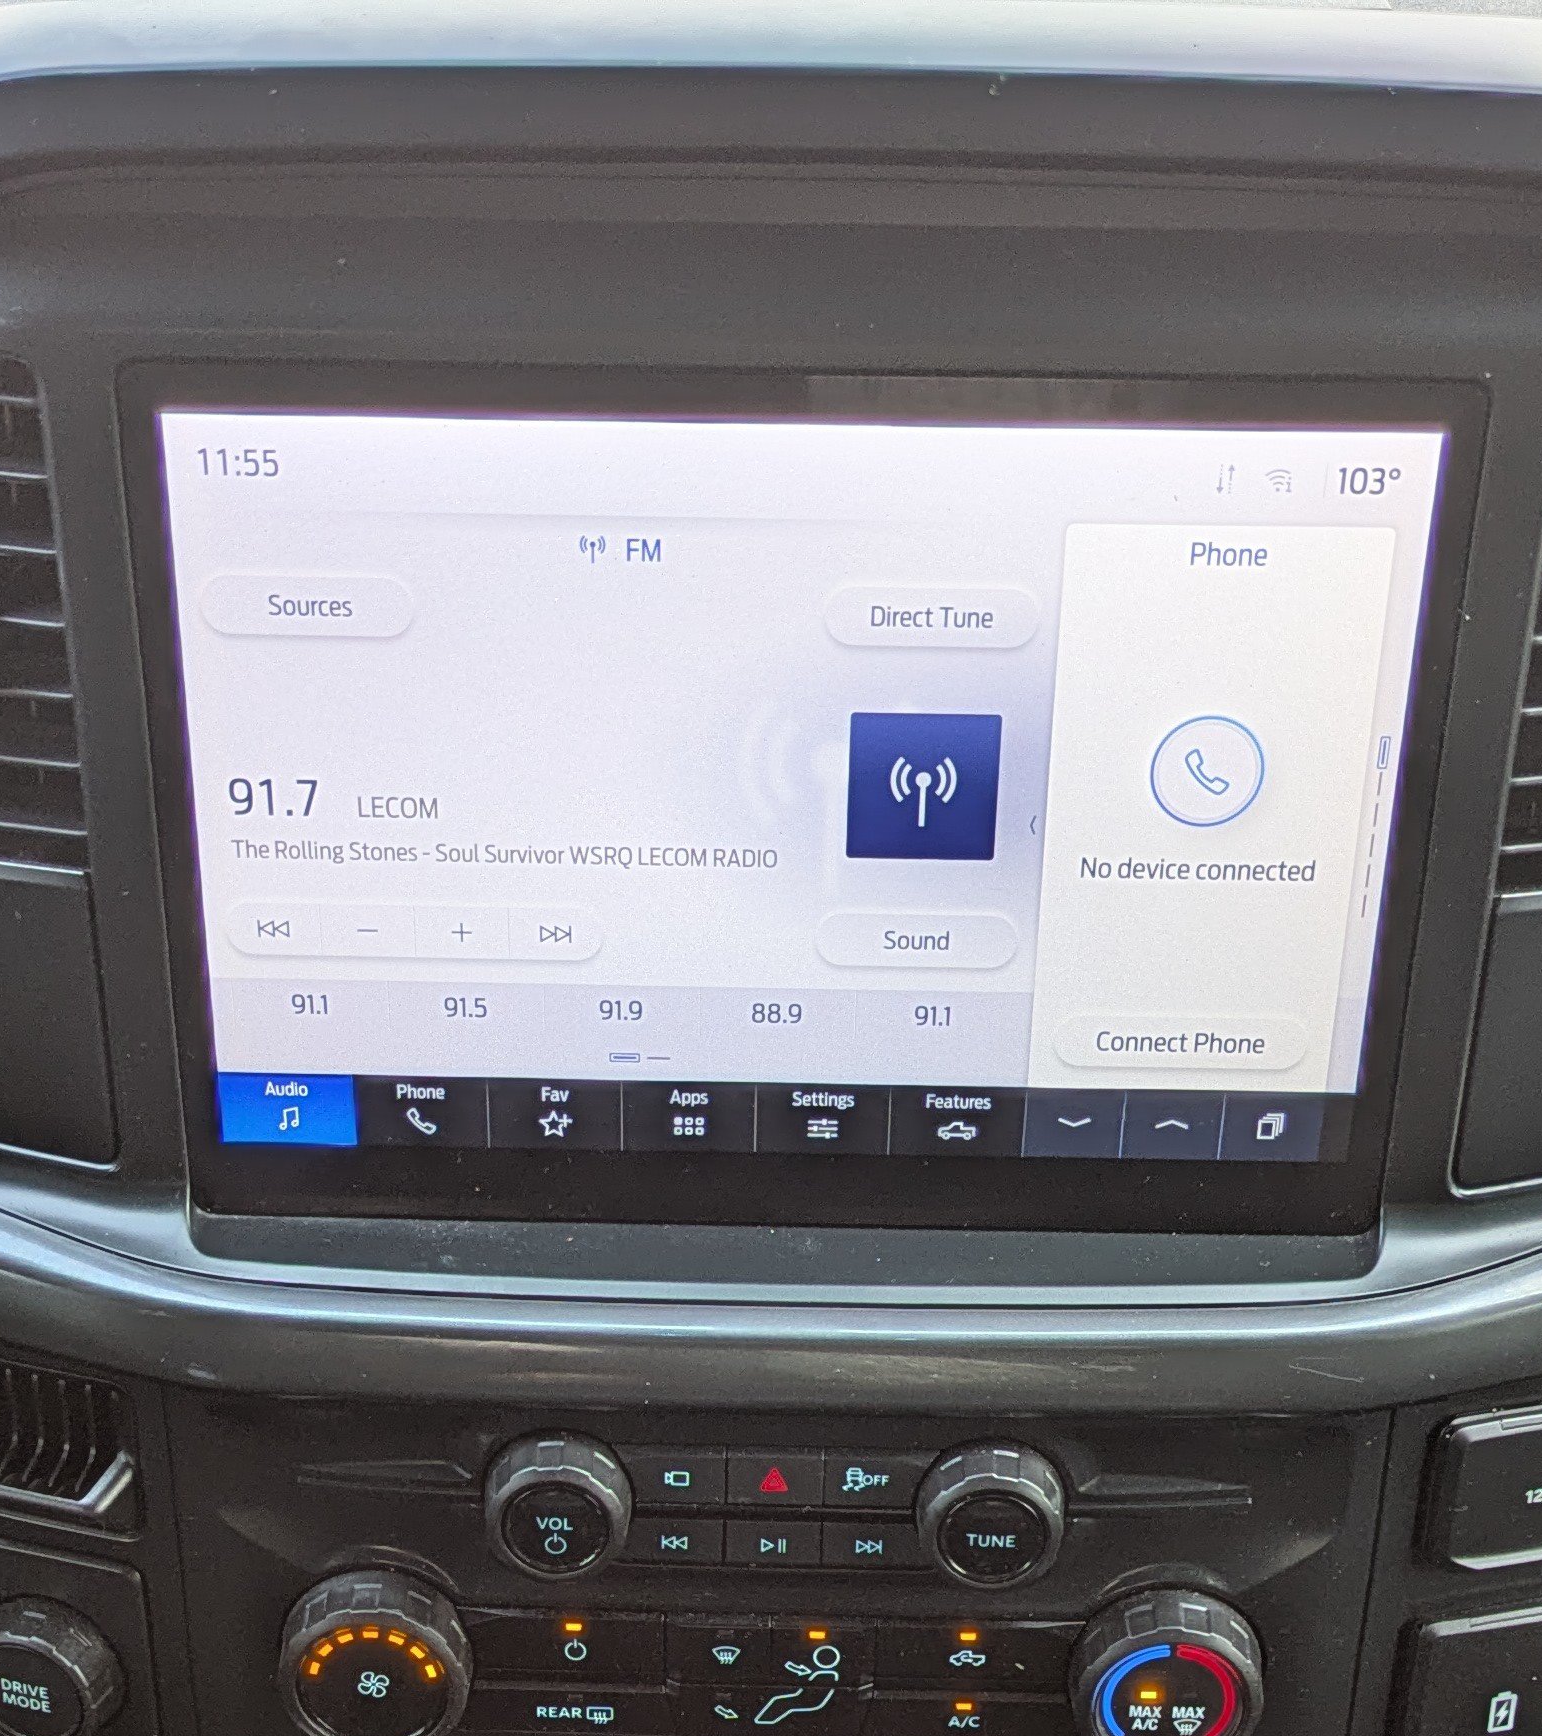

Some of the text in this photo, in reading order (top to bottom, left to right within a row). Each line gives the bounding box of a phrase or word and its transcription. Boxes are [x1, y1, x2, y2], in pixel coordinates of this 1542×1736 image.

[197, 447, 279, 477] 11:55
[1339, 467, 1401, 495] 103°
[626, 538, 661, 563] FM
[1190, 541, 1268, 567] Phone
[268, 594, 353, 618] Sources
[870, 605, 994, 629] Direct Tune
[228, 777, 438, 819] 91.7 LECOM
[230, 839, 270, 859] The
[274, 840, 345, 865] Rolling
[349, 841, 418, 862] Stones
[435, 843, 480, 863] Soul
[484, 844, 565, 865] Survivor
[569, 845, 633, 870] WSRQ
[638, 846, 707, 867] LECOM
[713, 848, 778, 869] RADIO
[1080, 857, 1317, 882] No device connected
[883, 930, 950, 951] Sound
[291, 993, 328, 1015] 91.1
[444, 996, 488, 1018] 91.5
[599, 999, 643, 1021] 91.9
[751, 1002, 802, 1024] 88.9
[914, 1005, 951, 1027] 91.1
[1096, 1031, 1265, 1054] Connect Phone
[264, 1081, 309, 1097] Audio
[396, 1083, 446, 1100] Phone
[541, 1086, 570, 1103] Fav
[669, 1088, 709, 1107] Apps
[791, 1091, 855, 1110] Settings
[925, 1093, 992, 1110] Features
[861, 1474, 890, 1487] OFF
[535, 1516, 574, 1531] VOL
[965, 1533, 1016, 1548] TUNE
[0, 1677, 50, 1700] DRIVE
[2, 1691, 52, 1713] MODE
[536, 1706, 583, 1719] REAR
[1128, 1704, 1162, 1719] MAX
[1171, 1705, 1206, 1720] MAX
[947, 1715, 980, 1729] A/C
[1131, 1716, 1160, 1731] A/C
